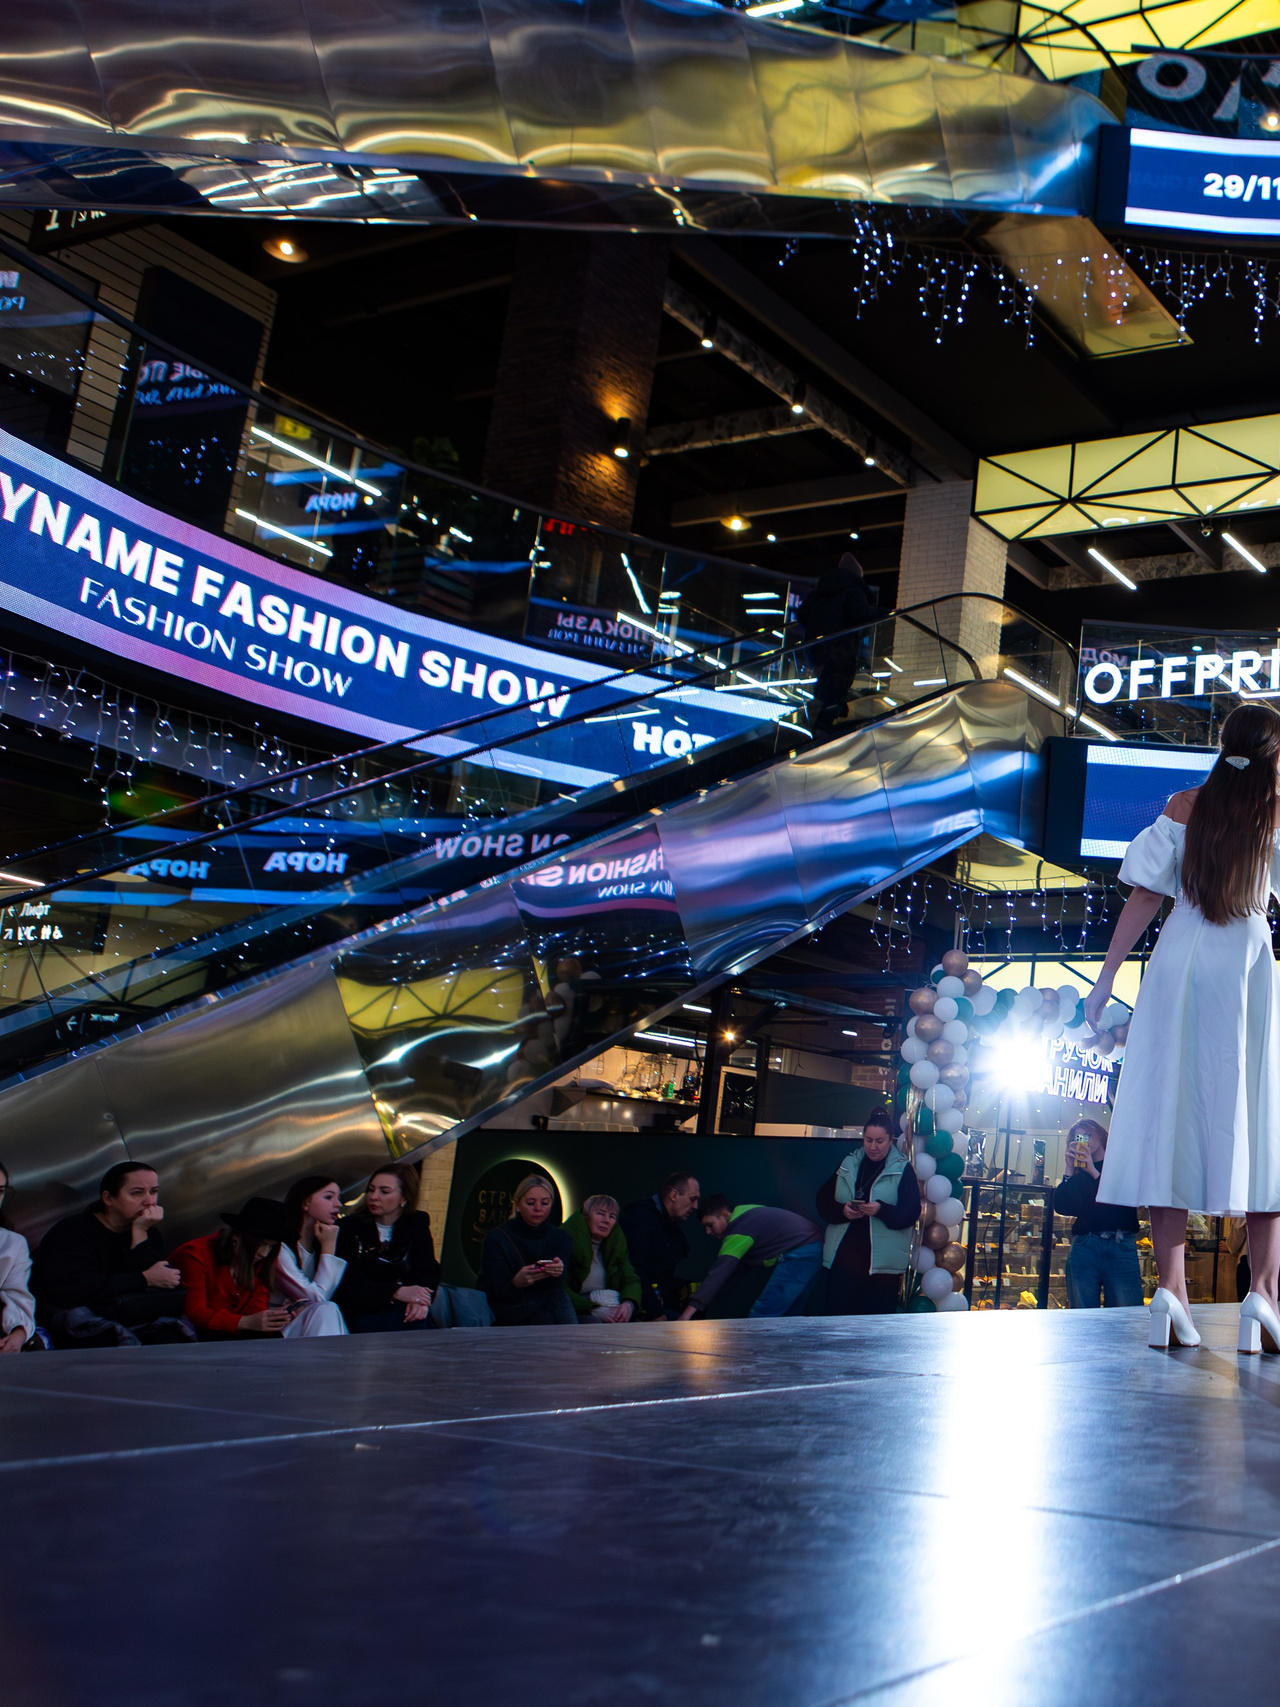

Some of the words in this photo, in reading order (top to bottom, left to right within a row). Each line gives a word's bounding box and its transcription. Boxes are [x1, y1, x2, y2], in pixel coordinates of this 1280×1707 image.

[0, 471, 184, 596] YNAME
[191, 564, 411, 678] FASHION
[418, 650, 571, 718] SHOW
[80, 576, 236, 660] FASHION
[244, 643, 353, 698] SHOW
[631, 721, 718, 758] НО
[19, 901, 52, 919] Лифт
[1027, 1062, 1109, 1104] АНИЛИ
